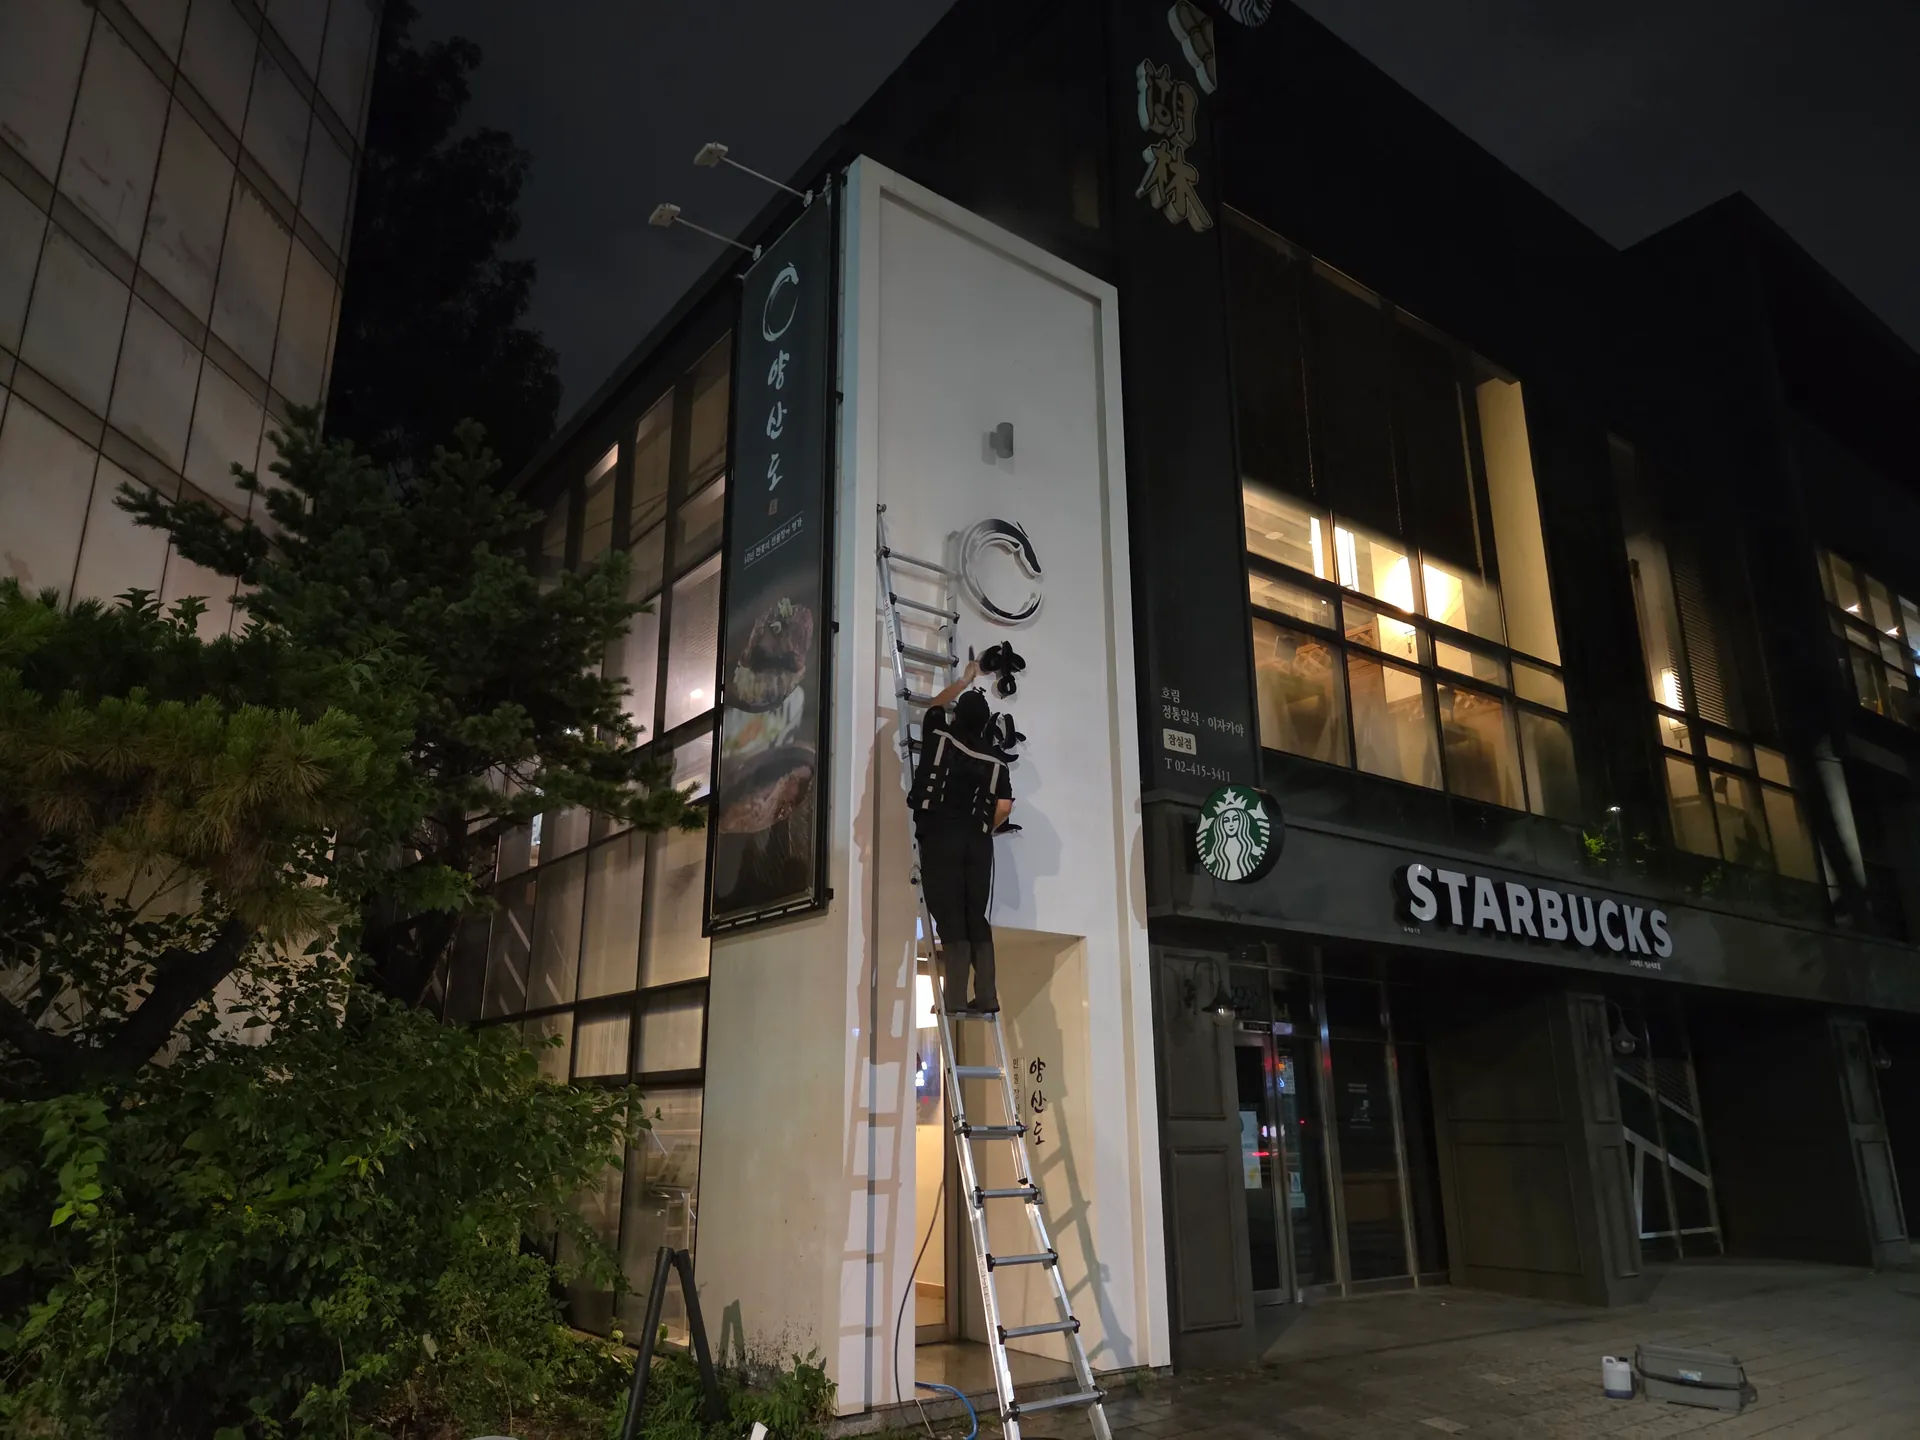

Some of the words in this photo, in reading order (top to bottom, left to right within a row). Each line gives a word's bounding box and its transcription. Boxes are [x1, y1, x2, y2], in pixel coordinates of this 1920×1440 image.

[766, 349, 790, 492] 양산도
[1160, 686, 1181, 704] 호림
[1162, 704, 1200, 726] 정통일식
[1207, 716, 1245, 738] 이자카야
[1167, 733, 1192, 751] 잠실점
[1164, 757, 1173, 770] T
[1406, 863, 1673, 958] STARBUCKS
[1029, 1056, 1047, 1146] 양산도
